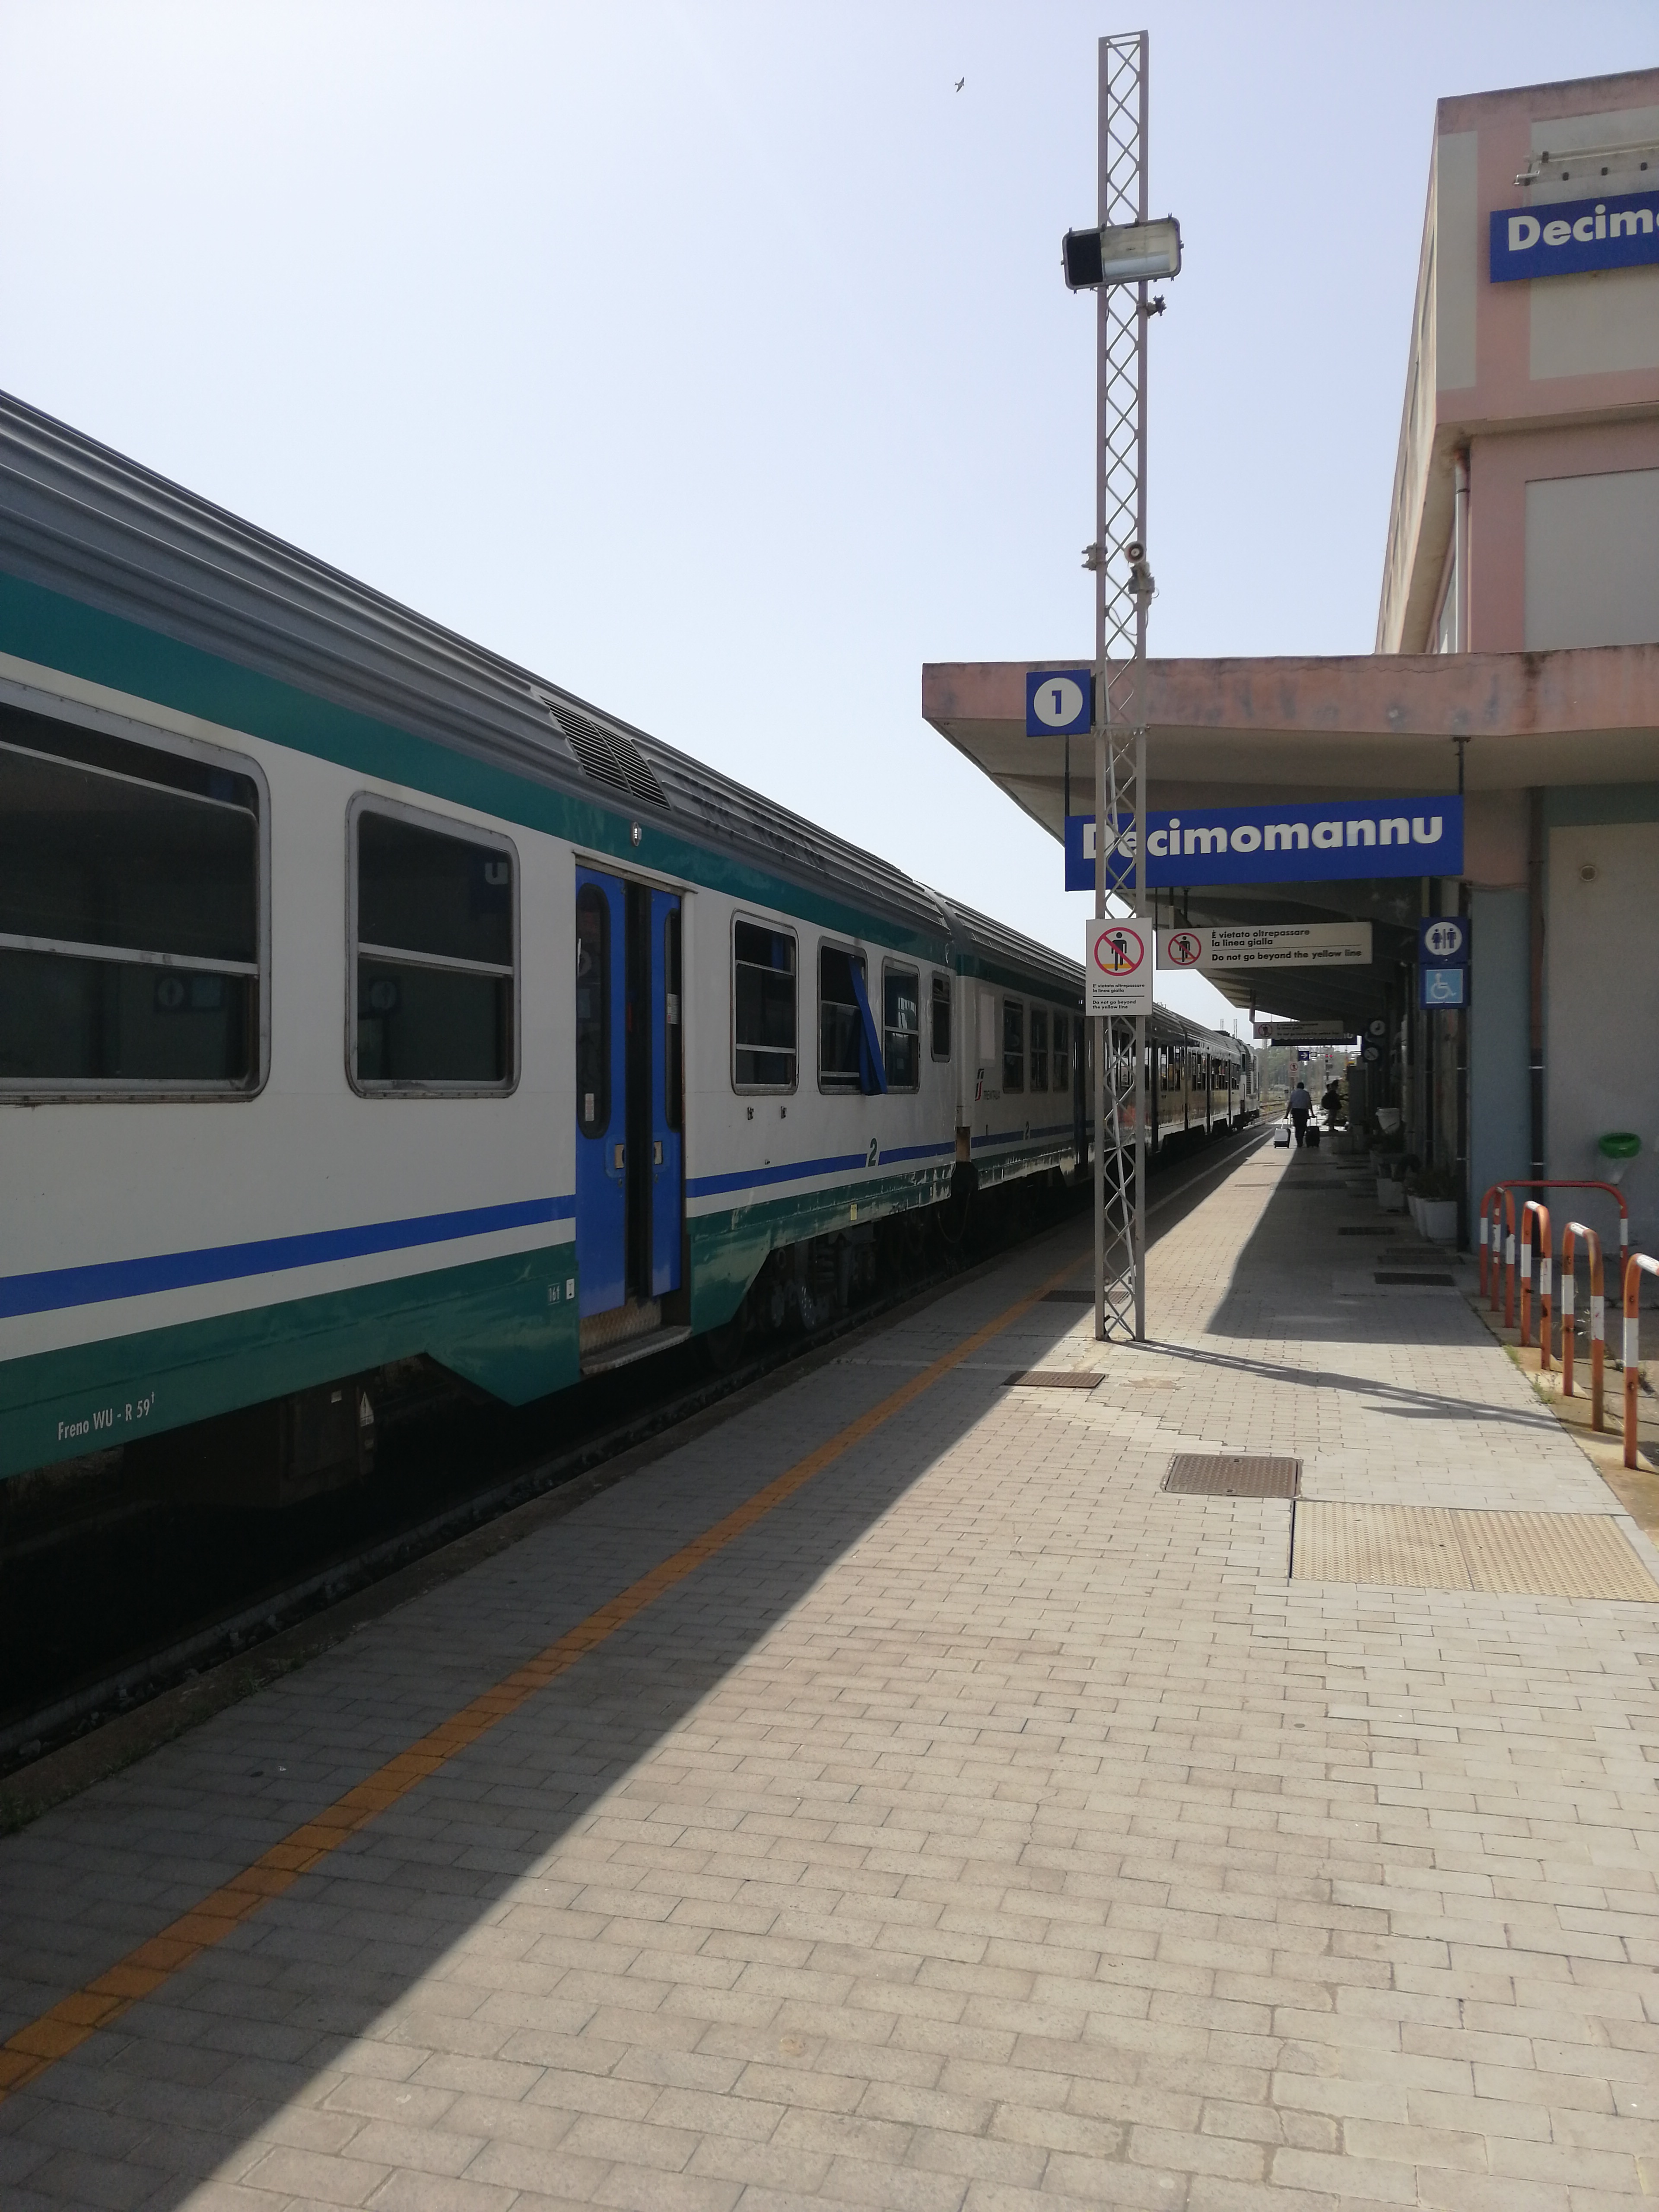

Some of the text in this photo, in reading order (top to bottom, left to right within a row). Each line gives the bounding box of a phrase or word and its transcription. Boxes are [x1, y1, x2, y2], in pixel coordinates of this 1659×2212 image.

[1508, 204, 1659, 251] Decim
[1052, 690, 1062, 715] 1
[1083, 816, 1442, 859] Decimomannu
[1248, 938, 1273, 947] gialla
[1253, 929, 1310, 938] oltrepassare
[1258, 951, 1291, 960] beyond
[1312, 950, 1342, 959] yellow
[1025, 1121, 1029, 1140] 2
[868, 1138, 877, 1167] 2
[58, 1420, 89, 1440] Freno
[92, 1408, 113, 1430] WU
[125, 1404, 132, 1421] R
